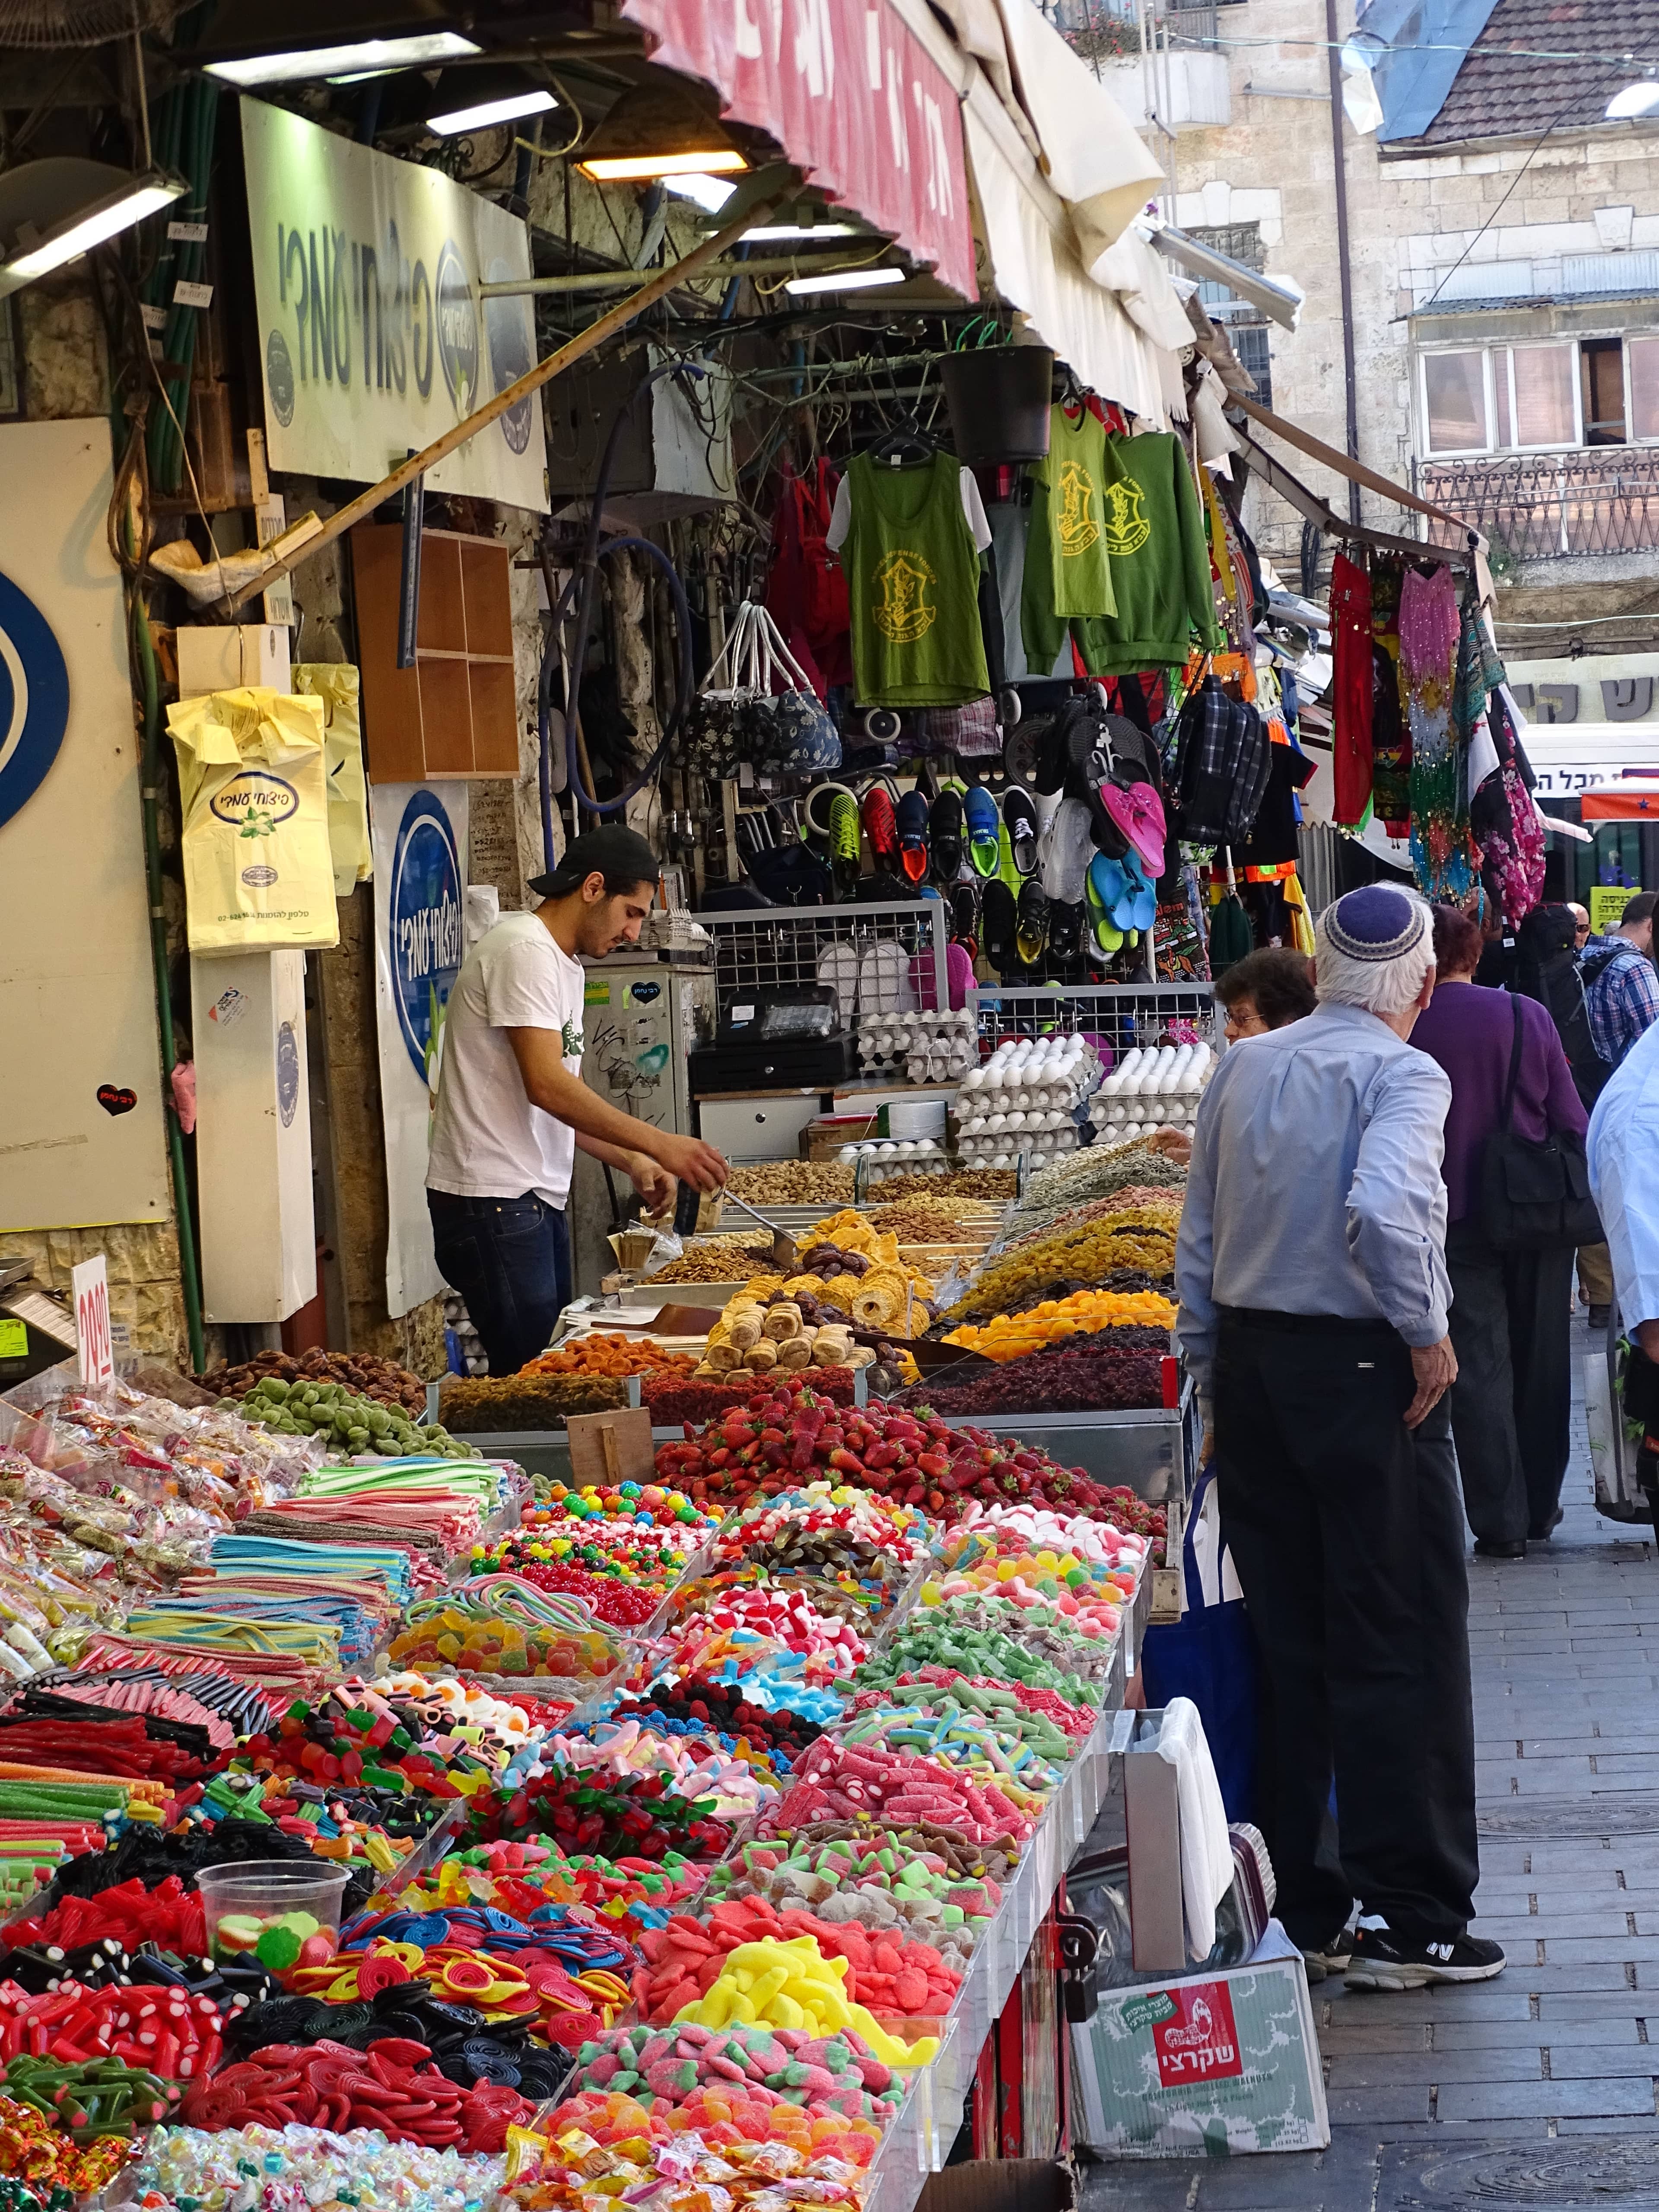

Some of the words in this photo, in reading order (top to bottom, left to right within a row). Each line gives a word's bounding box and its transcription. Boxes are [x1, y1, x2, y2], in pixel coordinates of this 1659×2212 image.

[1600, 676, 1659, 722] ש
[1535, 774, 1552, 790] ה
[254, 791, 289, 805] פיצוחי
[256, 911, 286, 919] להזמנות
[287, 910, 309, 921] טלפון
[431, 889, 458, 969] פיצוחי
[1147, 1993, 1169, 2009] מוצרי
[1125, 2005, 1147, 2021] איכות
[1154, 2002, 1173, 2018] מבית
[1162, 2045, 1235, 2073] שקרצי
